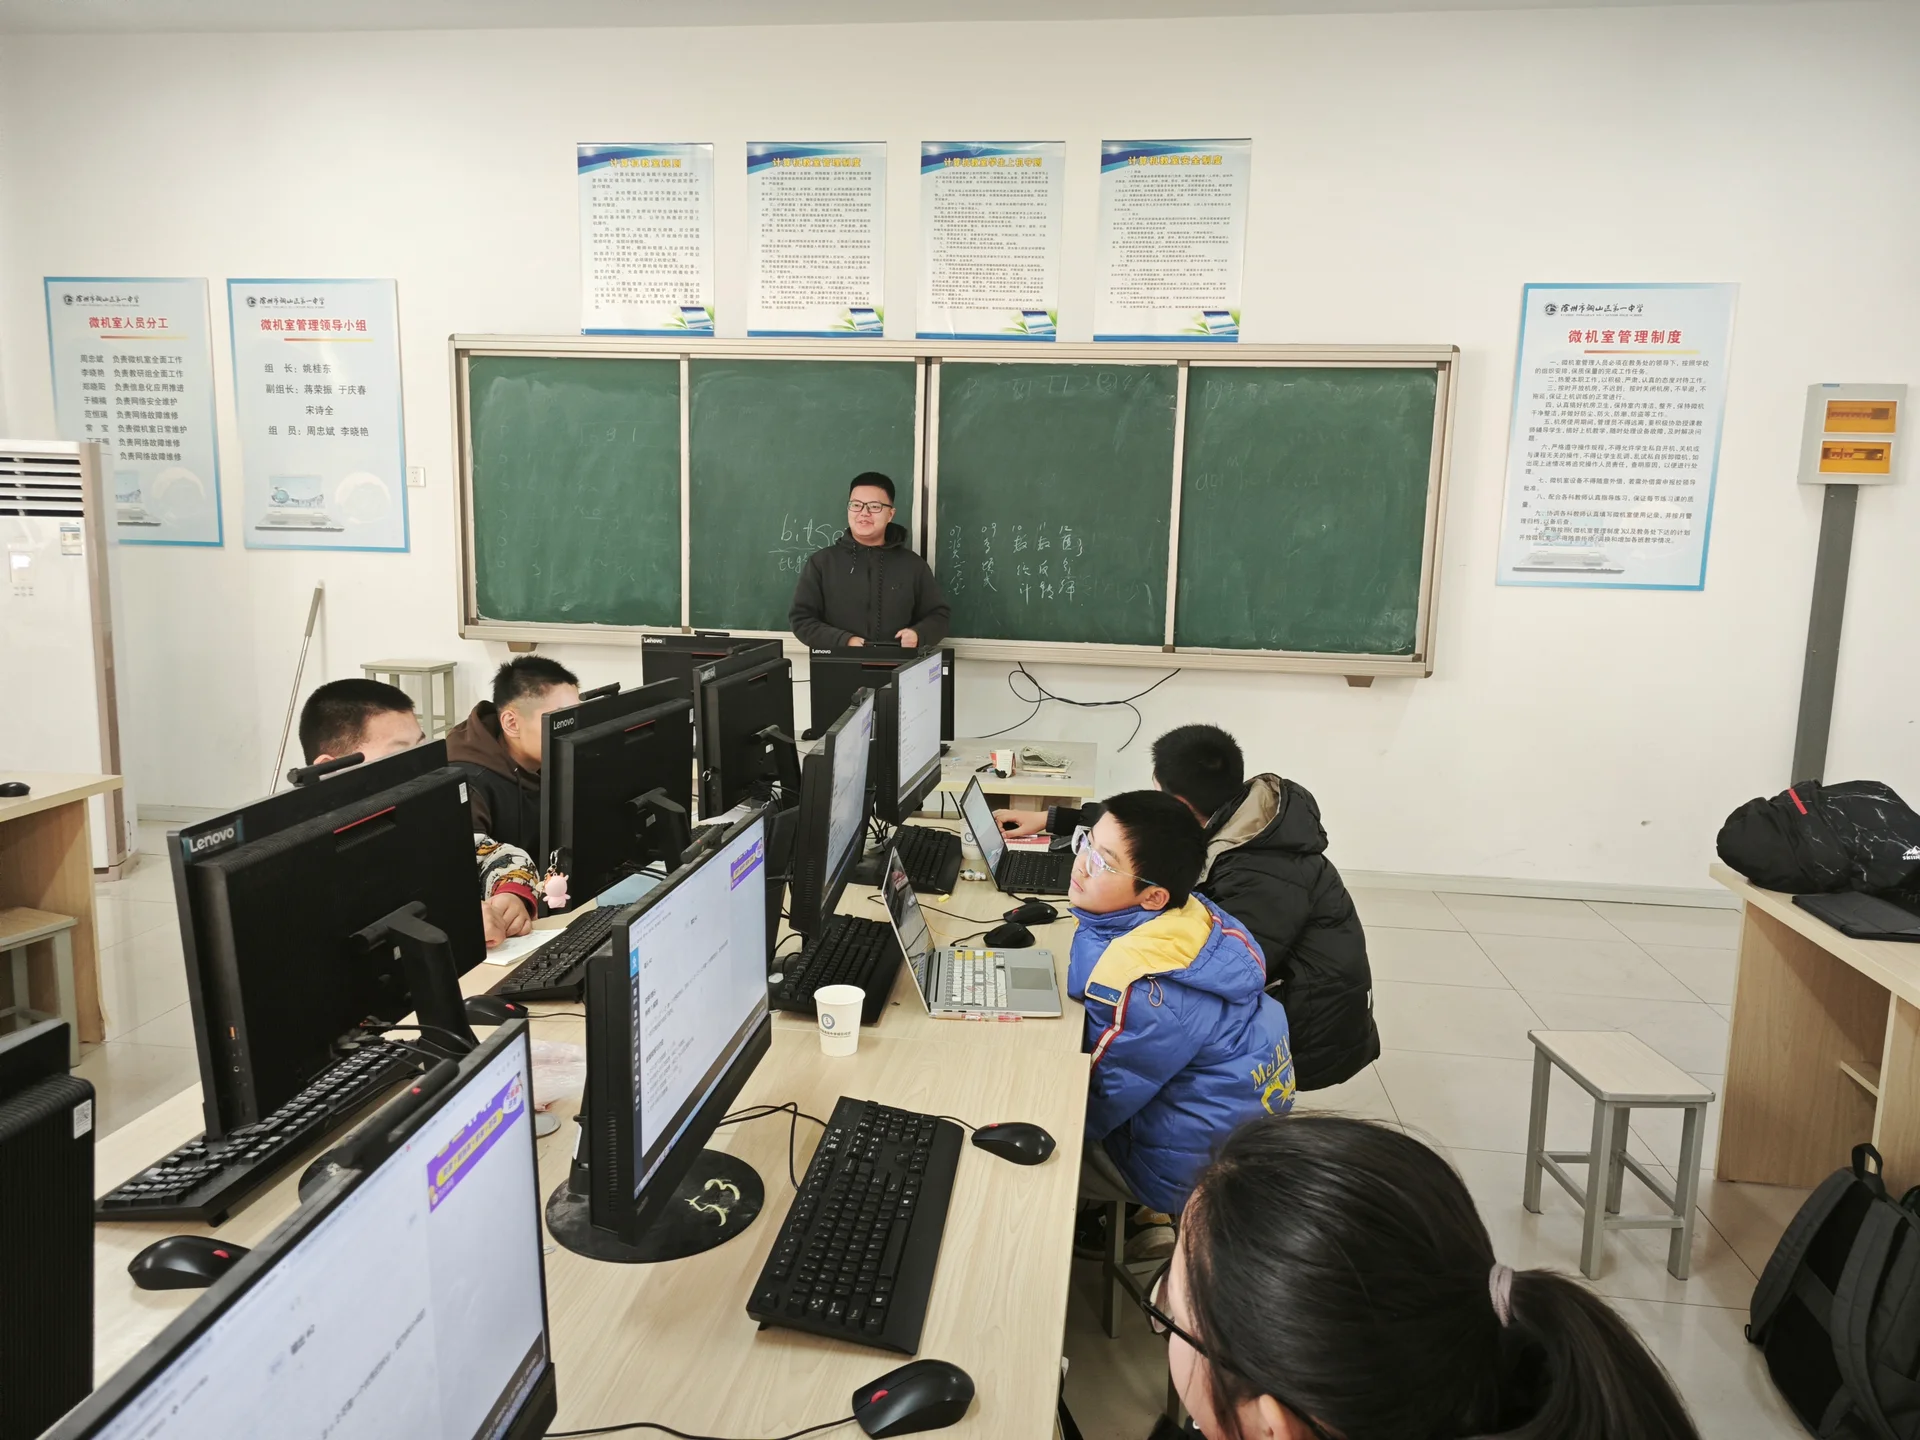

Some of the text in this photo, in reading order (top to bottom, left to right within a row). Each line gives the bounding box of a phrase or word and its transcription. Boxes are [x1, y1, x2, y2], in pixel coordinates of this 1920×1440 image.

[772, 158, 861, 167] 计算机教室管理制度
[943, 157, 1043, 167] 计算机教室学生上机守则
[1127, 155, 1223, 165] 计算机教室安全制度
[88, 316, 169, 329] 微机室人员分工
[260, 318, 367, 332] 微机室管理领导小组
[1568, 329, 1682, 344] 微机室管理制度
[112, 354, 182, 364] 负责微机室全面工作
[113, 368, 183, 378] 负责教研组全面工作
[264, 363, 274, 373] 组
[302, 363, 332, 374] 姚桂东
[114, 382, 184, 393] 负责信息化应用推进
[304, 384, 333, 395] 蒋荣振
[338, 384, 367, 396] 于庆春
[115, 396, 178, 406] 负责网络安全维护
[116, 410, 179, 420] 负责网络故障维修
[305, 405, 334, 416] 宋诗全
[117, 424, 188, 434] 负责微机室日常维护
[268, 425, 278, 436] 组
[306, 425, 336, 436] 周忠斌
[118, 438, 180, 448] 负责网络故障维修
[119, 451, 182, 462] 负责网络故障维修
[780, 512, 847, 550] bitSe
[553, 717, 575, 730] Lenovo
[189, 827, 235, 853] Lenovo
